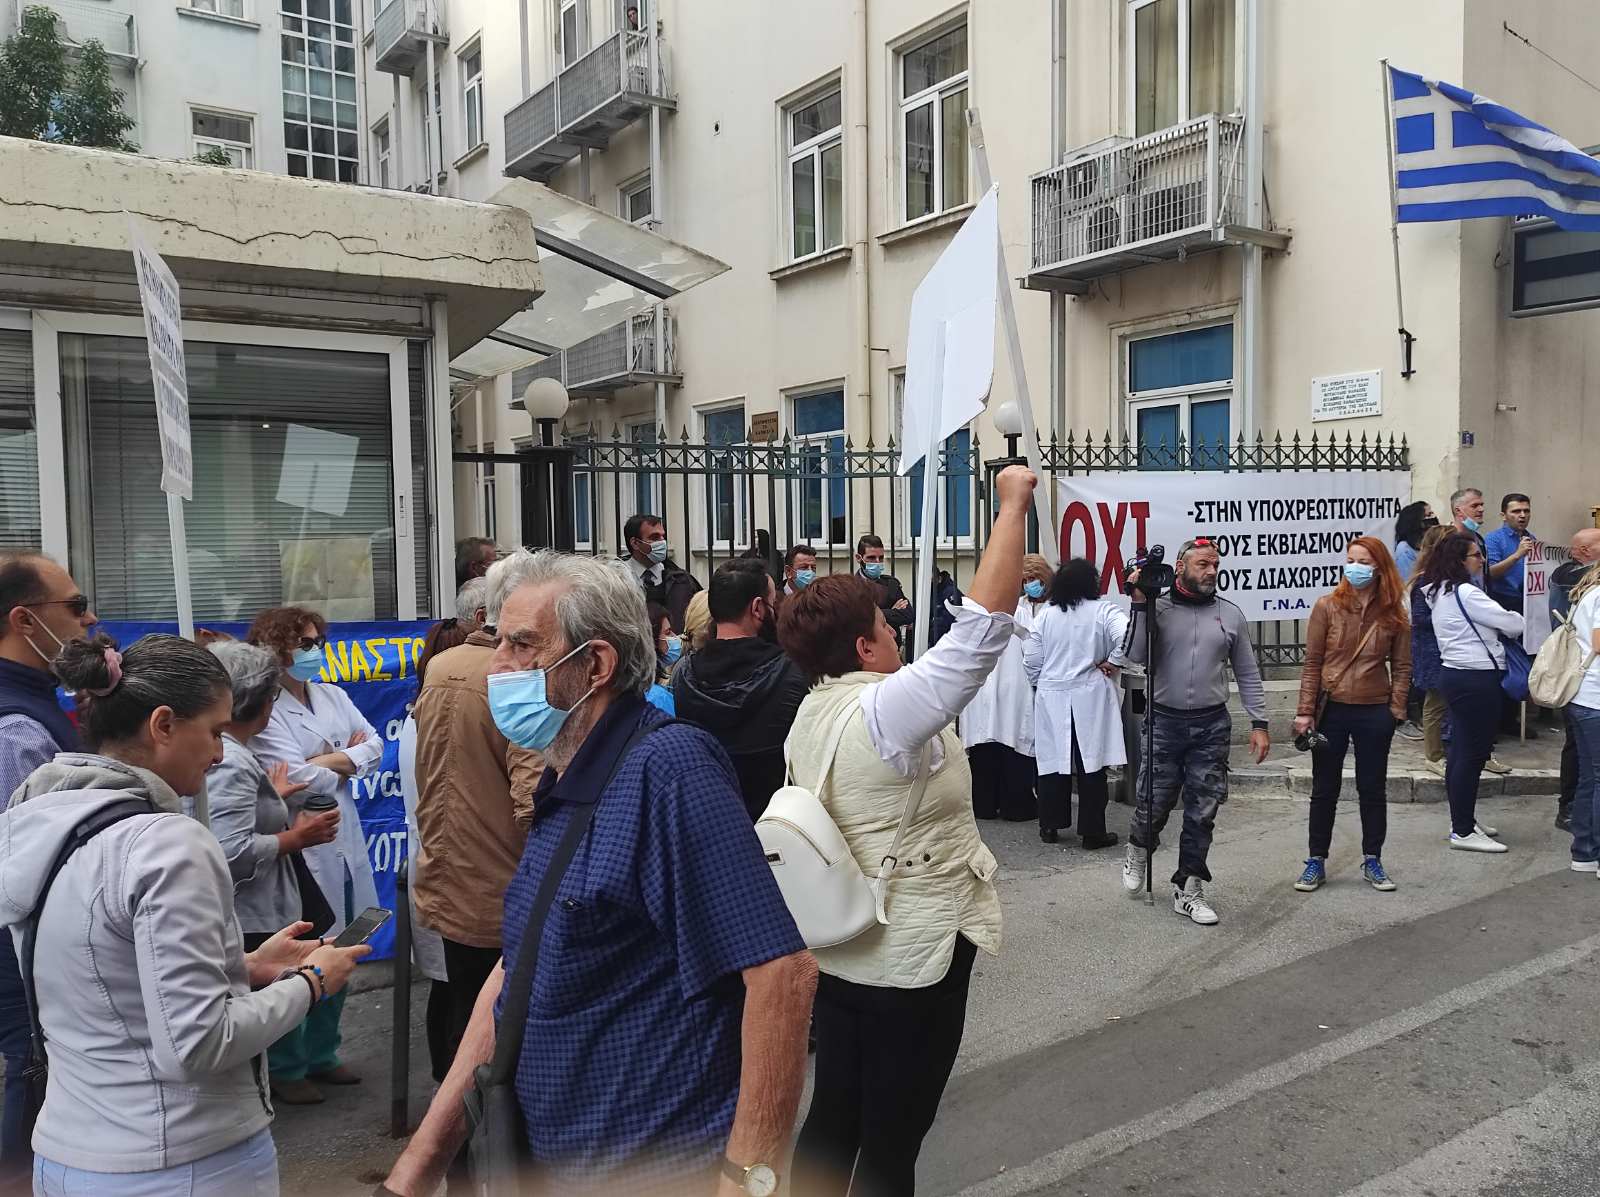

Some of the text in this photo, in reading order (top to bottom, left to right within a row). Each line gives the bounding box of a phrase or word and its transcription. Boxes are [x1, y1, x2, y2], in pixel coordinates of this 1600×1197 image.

[1187, 497, 1401, 523] -ΣΤΗΝ ΥΠΟΧΡΕΩΤΙΚΟΤΗΤΑ
[1196, 531, 1363, 557] ΟΥΣ ΕΚΒΙΑΣΜΟΥ
[1257, 565, 1344, 590] ΔΙΑΧΩΡΙΣ
[320, 638, 426, 682] ΝΑΣΤΟ
